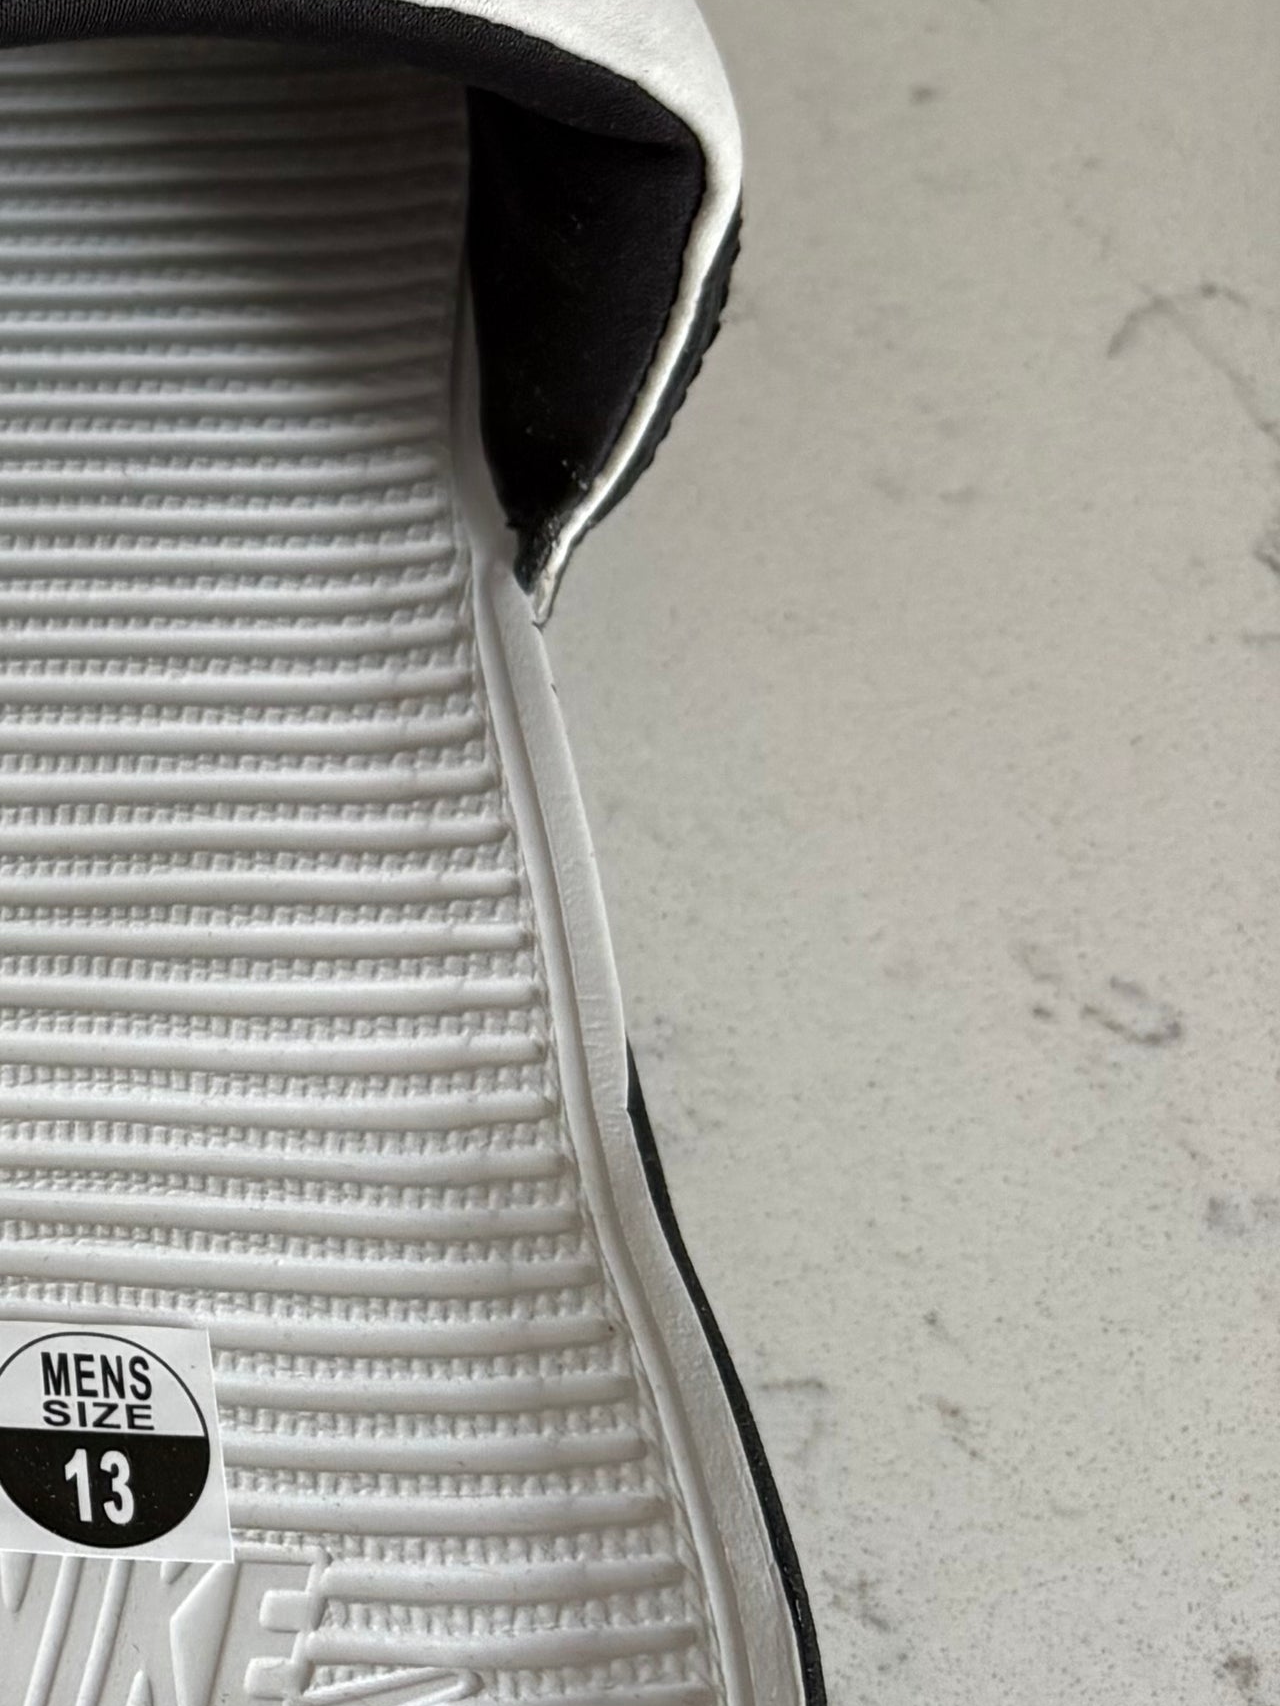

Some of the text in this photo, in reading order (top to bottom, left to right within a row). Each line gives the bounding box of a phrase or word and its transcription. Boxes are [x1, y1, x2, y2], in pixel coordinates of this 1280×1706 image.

[40, 1351, 154, 1401] MENS
[41, 1399, 156, 1432] SIZE
[63, 1447, 136, 1525] 13
